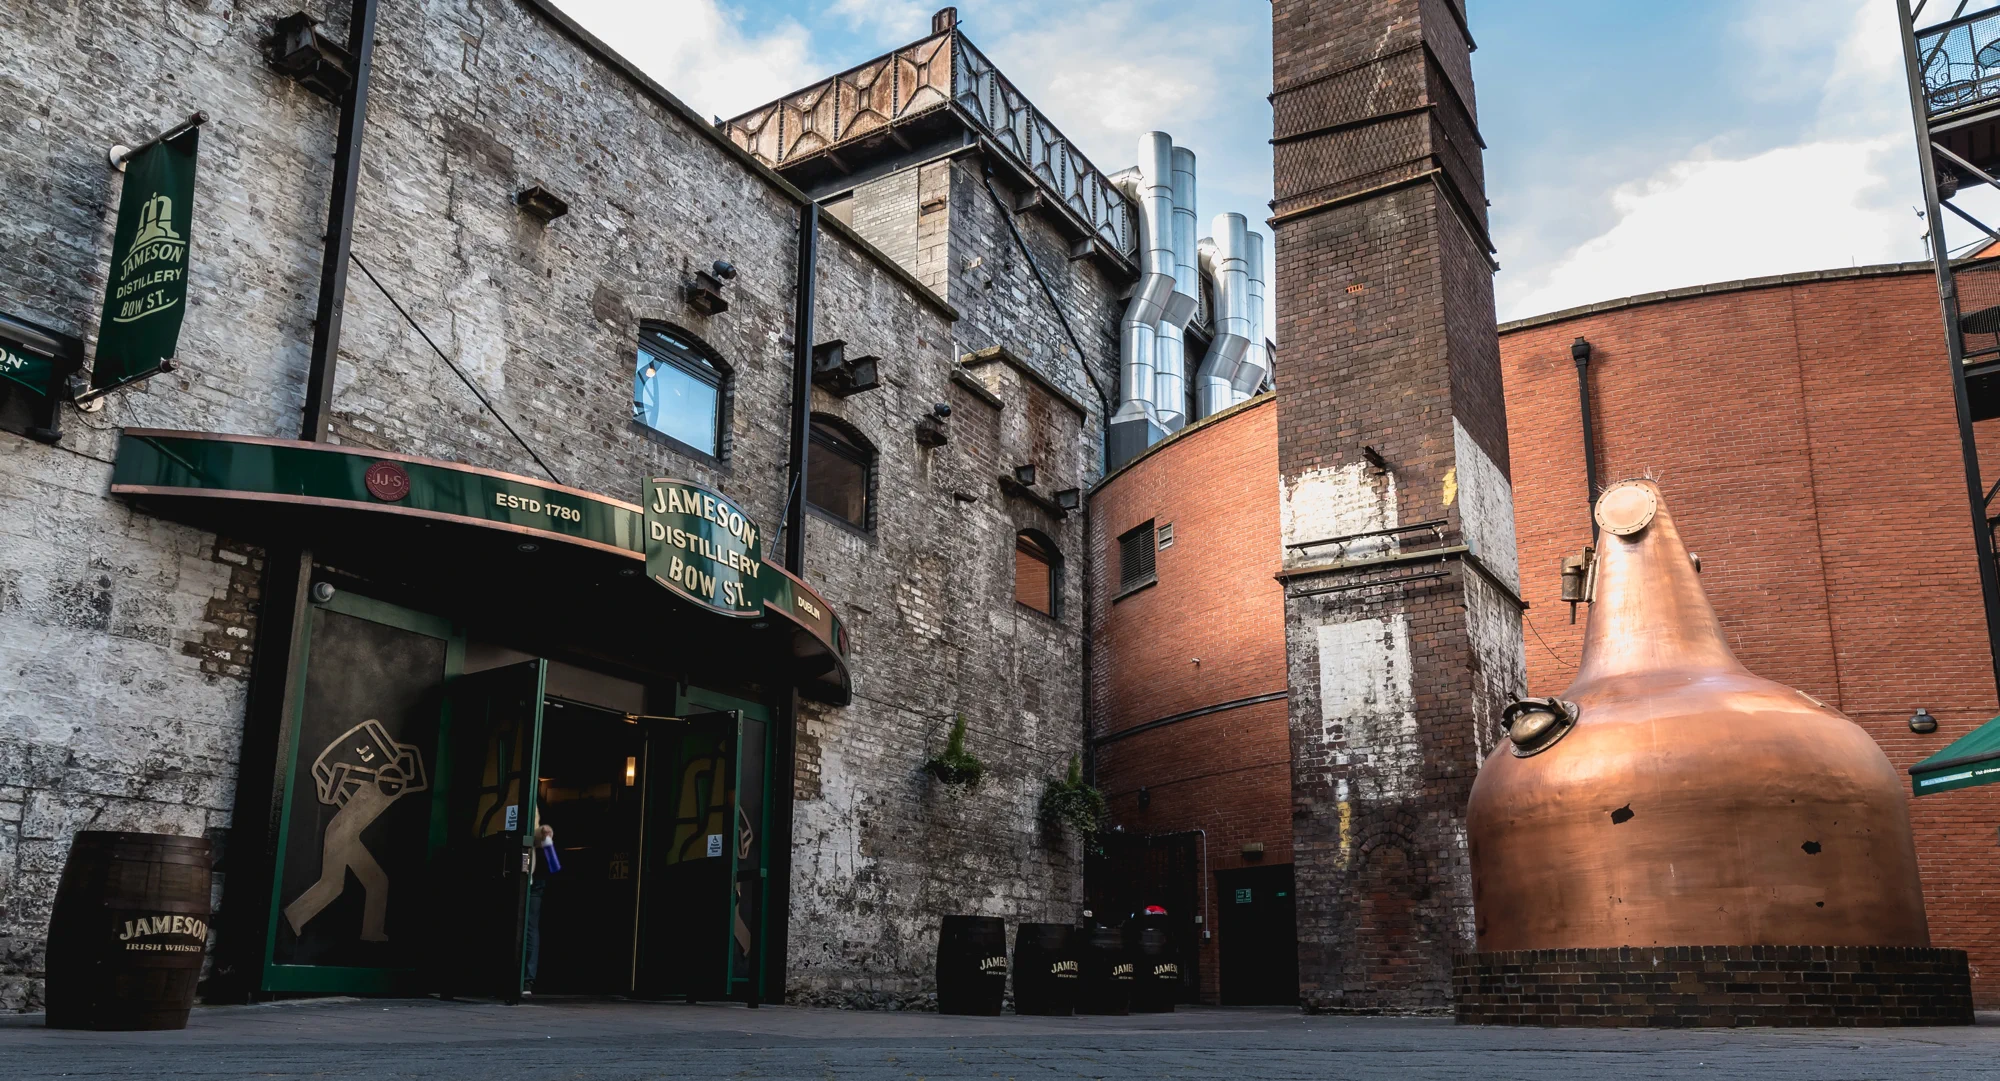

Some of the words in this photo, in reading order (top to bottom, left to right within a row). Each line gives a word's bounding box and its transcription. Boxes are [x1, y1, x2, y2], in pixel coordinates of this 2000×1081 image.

[121, 243, 184, 281] JAMESON
[116, 267, 183, 299] DISTILLERY
[121, 297, 144, 317] BOW
[147, 289, 170, 309] ST.
[496, 492, 541, 513] ESTD
[545, 503, 581, 522] 1780
[652, 487, 756, 550] JAMESON
[650, 520, 760, 579] DISTILLERY
[669, 555, 717, 599] BOW
[723, 580, 752, 607] ST.
[797, 595, 821, 621] DUBLIN
[120, 915, 208, 943] JAMESON
[126, 943, 162, 951] IRISH
[165, 944, 201, 953] WHISKEY
[979, 956, 1007, 971] JAMES
[1112, 963, 1134, 976] JAME
